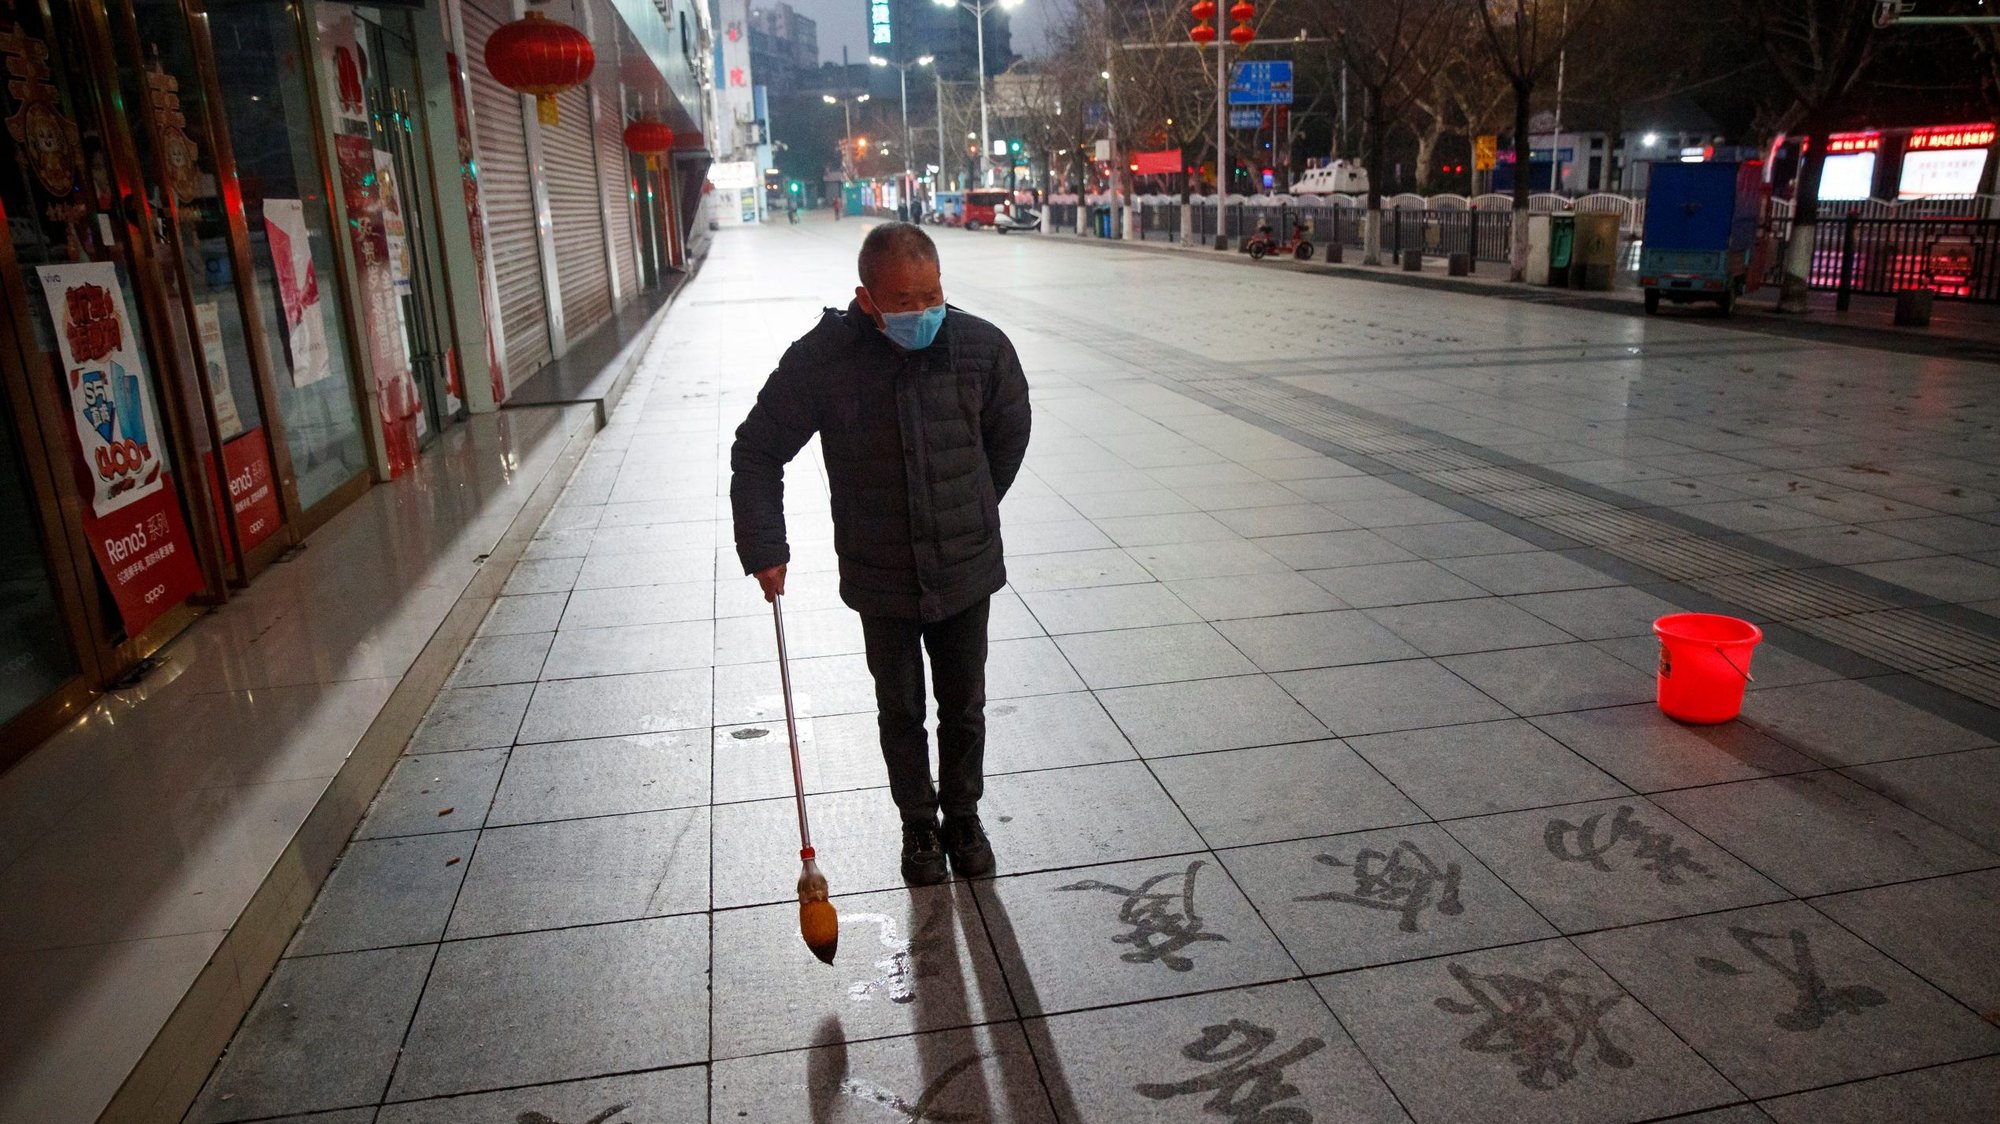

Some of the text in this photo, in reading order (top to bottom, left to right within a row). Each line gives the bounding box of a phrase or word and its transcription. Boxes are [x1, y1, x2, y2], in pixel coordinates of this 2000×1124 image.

[43, 273, 61, 283] vivo
[230, 467, 252, 496] eno3
[105, 523, 147, 566] Reno3
[144, 584, 165, 604] oppo
